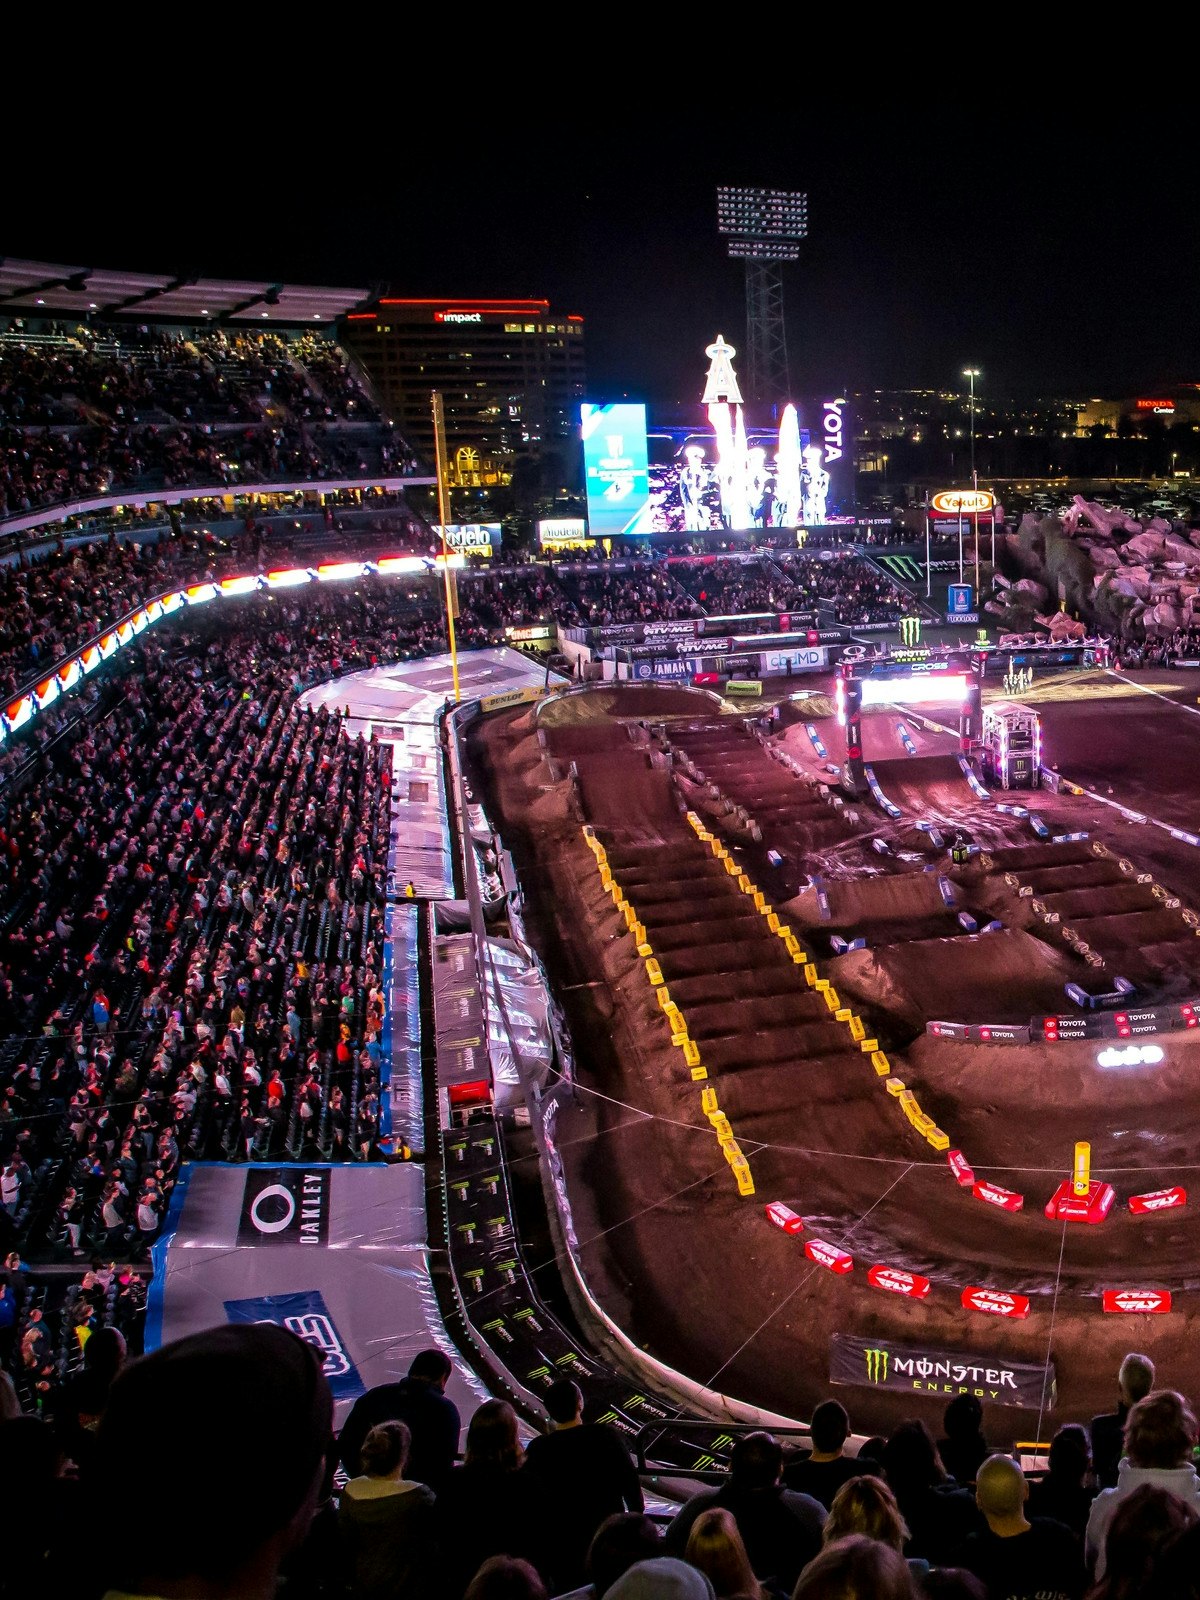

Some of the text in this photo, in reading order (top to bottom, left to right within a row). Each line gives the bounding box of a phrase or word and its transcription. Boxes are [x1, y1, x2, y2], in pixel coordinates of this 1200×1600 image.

[443, 313, 481, 323] impact
[1137, 400, 1175, 408] HONDA
[1153, 406, 1175, 415] Center
[944, 498, 986, 507] Yakult
[444, 526, 490, 546] odelo
[770, 651, 819, 667] cbdMD
[490, 692, 524, 705] DUNLOP
[1129, 1013, 1156, 1021] TOYOTA
[1132, 1025, 1157, 1033] TOYOTA
[992, 1031, 1015, 1039] TOYOTA
[1141, 1194, 1181, 1210] FLY
[300, 1174, 322, 1244] OAKLEY
[970, 1298, 1015, 1313] FLY
[1114, 1301, 1162, 1310] FLY
[894, 1357, 1018, 1389] MONSTER
[914, 1380, 999, 1399] ENERGY
